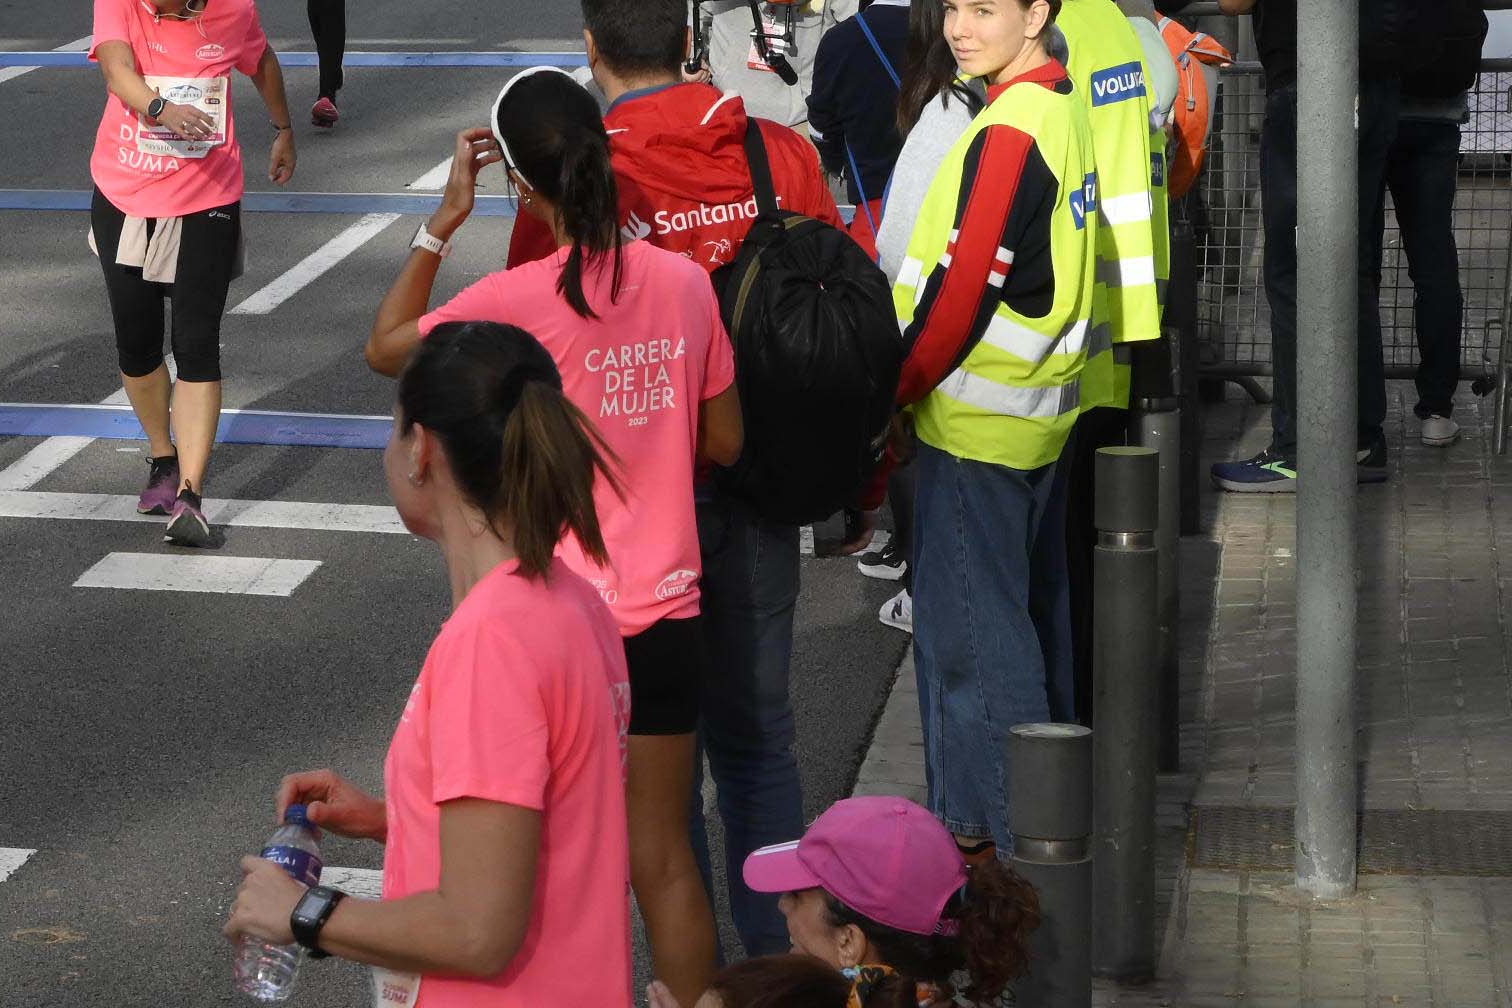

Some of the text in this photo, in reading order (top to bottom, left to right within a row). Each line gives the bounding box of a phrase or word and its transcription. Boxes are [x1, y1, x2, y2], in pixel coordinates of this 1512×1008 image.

[118, 147, 179, 172] SUMA
[585, 336, 688, 373] CARRERA
[605, 366, 670, 394] DE LA
[599, 386, 676, 419] MUJER
[628, 416, 648, 427] 2023
